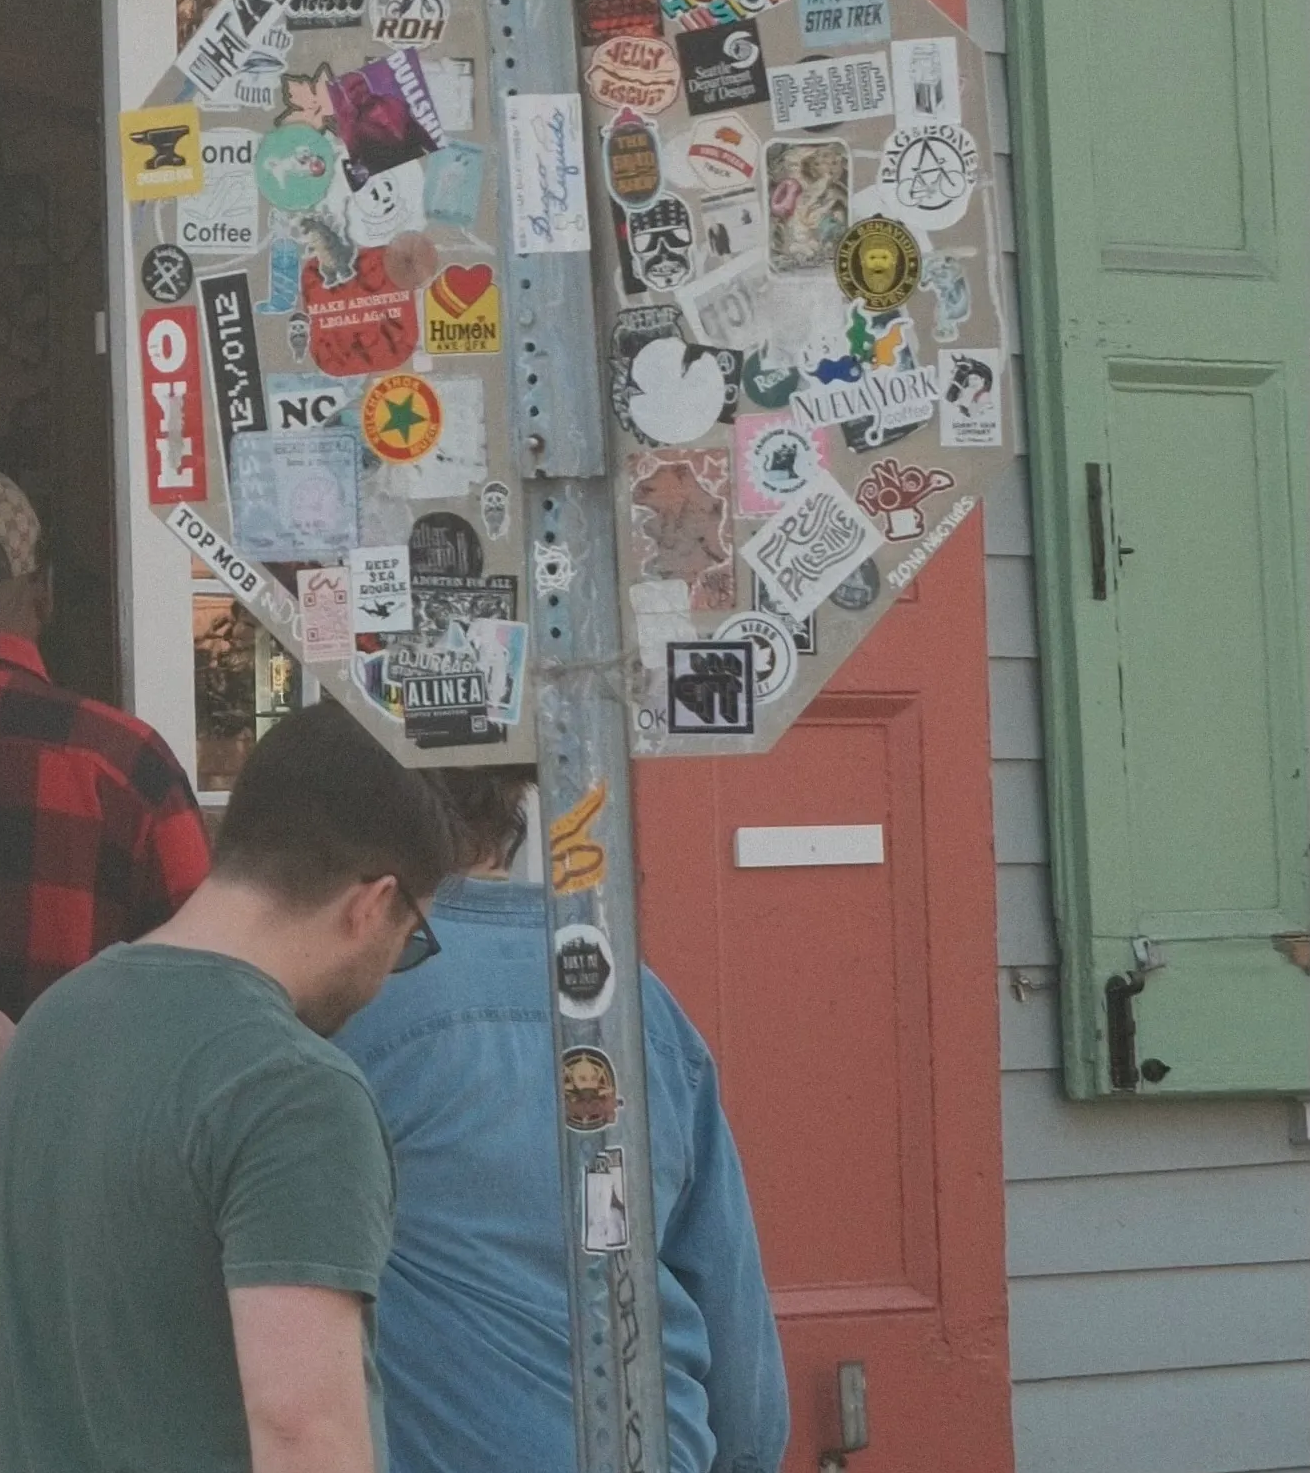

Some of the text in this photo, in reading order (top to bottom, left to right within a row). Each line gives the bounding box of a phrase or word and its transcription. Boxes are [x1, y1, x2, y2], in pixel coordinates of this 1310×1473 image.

[376, 17, 445, 41] RDH
[805, 3, 886, 34] STAR TREK
[188, 12, 252, 93] WHAT
[202, 140, 252, 164] ond
[182, 221, 252, 243] Coffee
[307, 289, 411, 316] MAKE ABORTION
[319, 313, 361, 330] LEGAL
[794, 370, 939, 424] NUEVA YORK
[756, 492, 835, 576] FREE
[176, 509, 258, 594] TOP MOB
[776, 508, 867, 603] PALESTINE
[365, 558, 401, 571] DEEP
[359, 582, 408, 596] DOUBLE
[369, 572, 396, 584] SEA
[490, 578, 514, 589] ALL
[407, 675, 483, 708] ALINEA
[637, 708, 666, 730] OK
